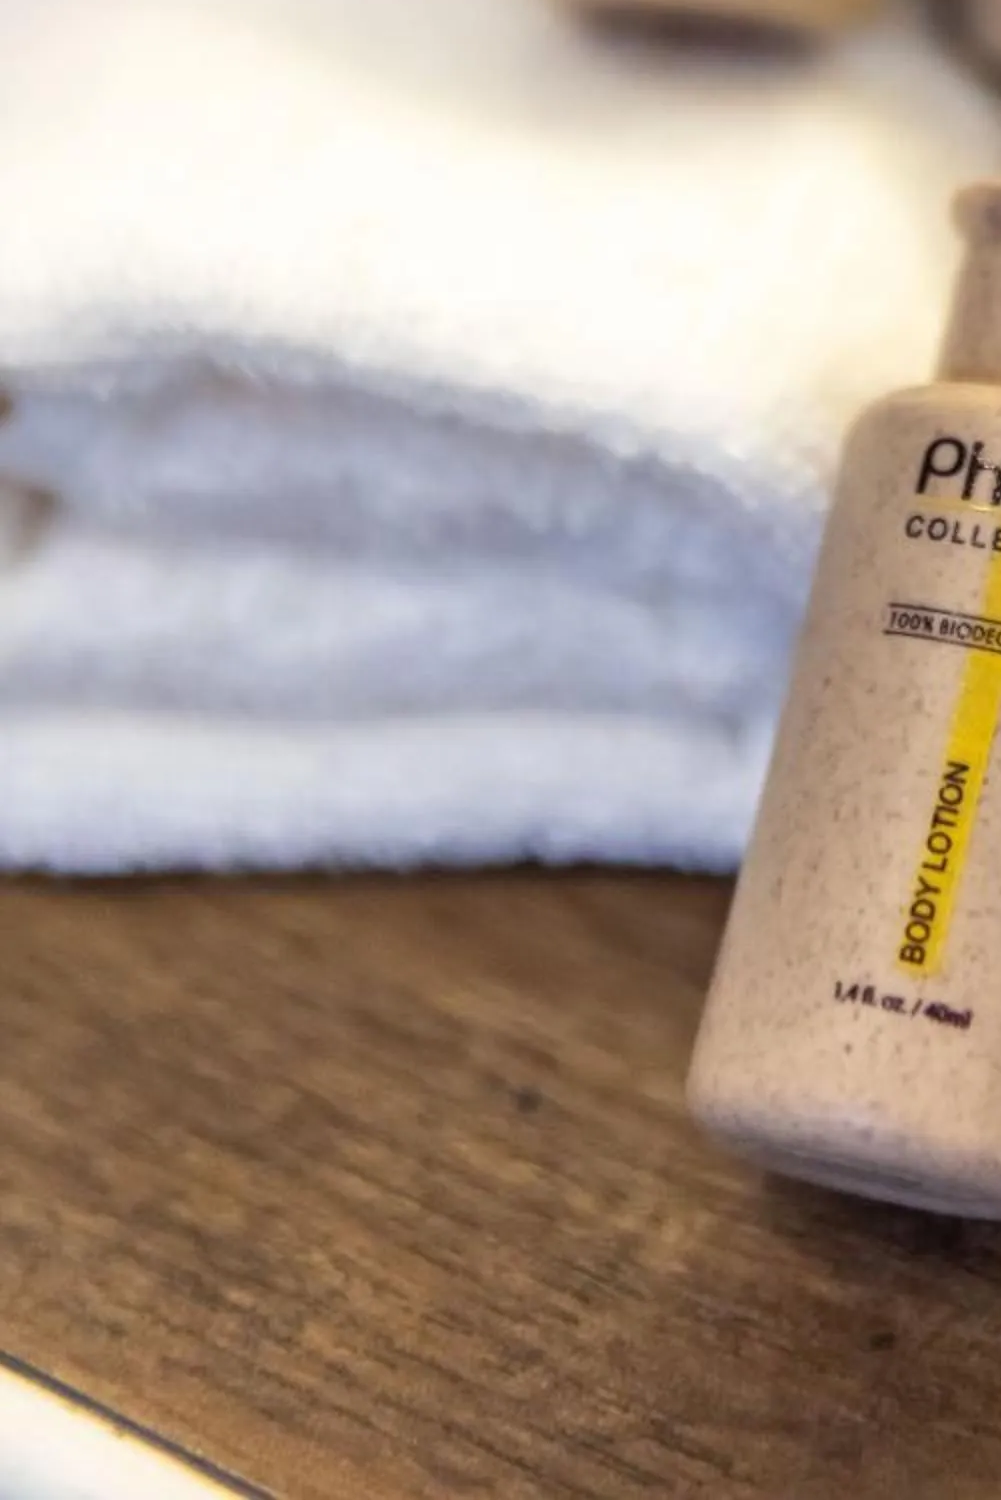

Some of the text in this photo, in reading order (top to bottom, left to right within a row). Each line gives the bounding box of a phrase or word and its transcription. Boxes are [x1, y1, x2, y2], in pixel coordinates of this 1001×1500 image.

[888, 609, 936, 634] 100%
[899, 760, 970, 966] BODY LOTION
